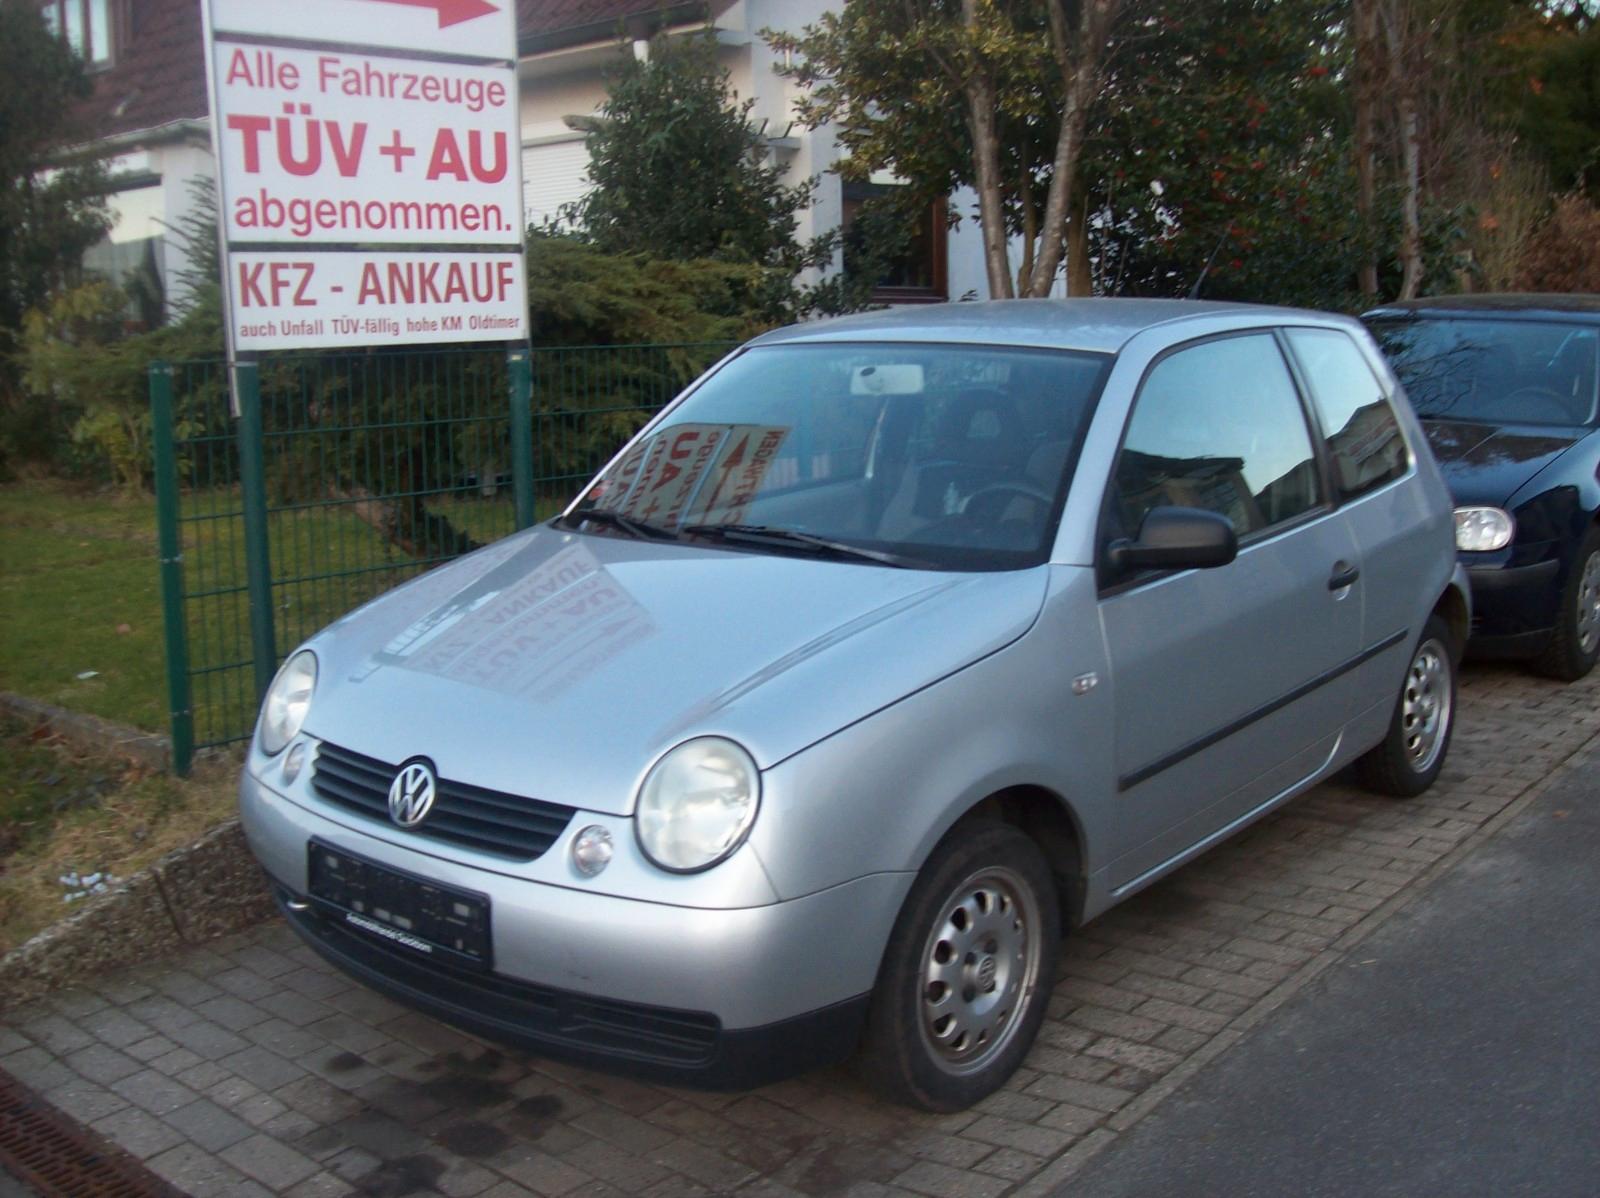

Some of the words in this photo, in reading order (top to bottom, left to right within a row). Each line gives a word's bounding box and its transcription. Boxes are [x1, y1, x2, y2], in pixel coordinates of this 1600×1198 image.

[226, 48, 300, 92] Alle
[318, 55, 507, 113] Fahrzeuge
[226, 101, 369, 178] TÜV
[425, 127, 509, 185] AU
[234, 187, 512, 238] abgenommen.
[239, 261, 319, 308] KFZ
[357, 261, 514, 306] ANKAUF
[240, 318, 277, 338] auch
[280, 317, 325, 337] Unfall
[331, 314, 401, 337] TÜV-fällig
[406, 317, 439, 333] hohe
[440, 316, 464, 332] KM
[468, 313, 520, 331] Oldtimer
